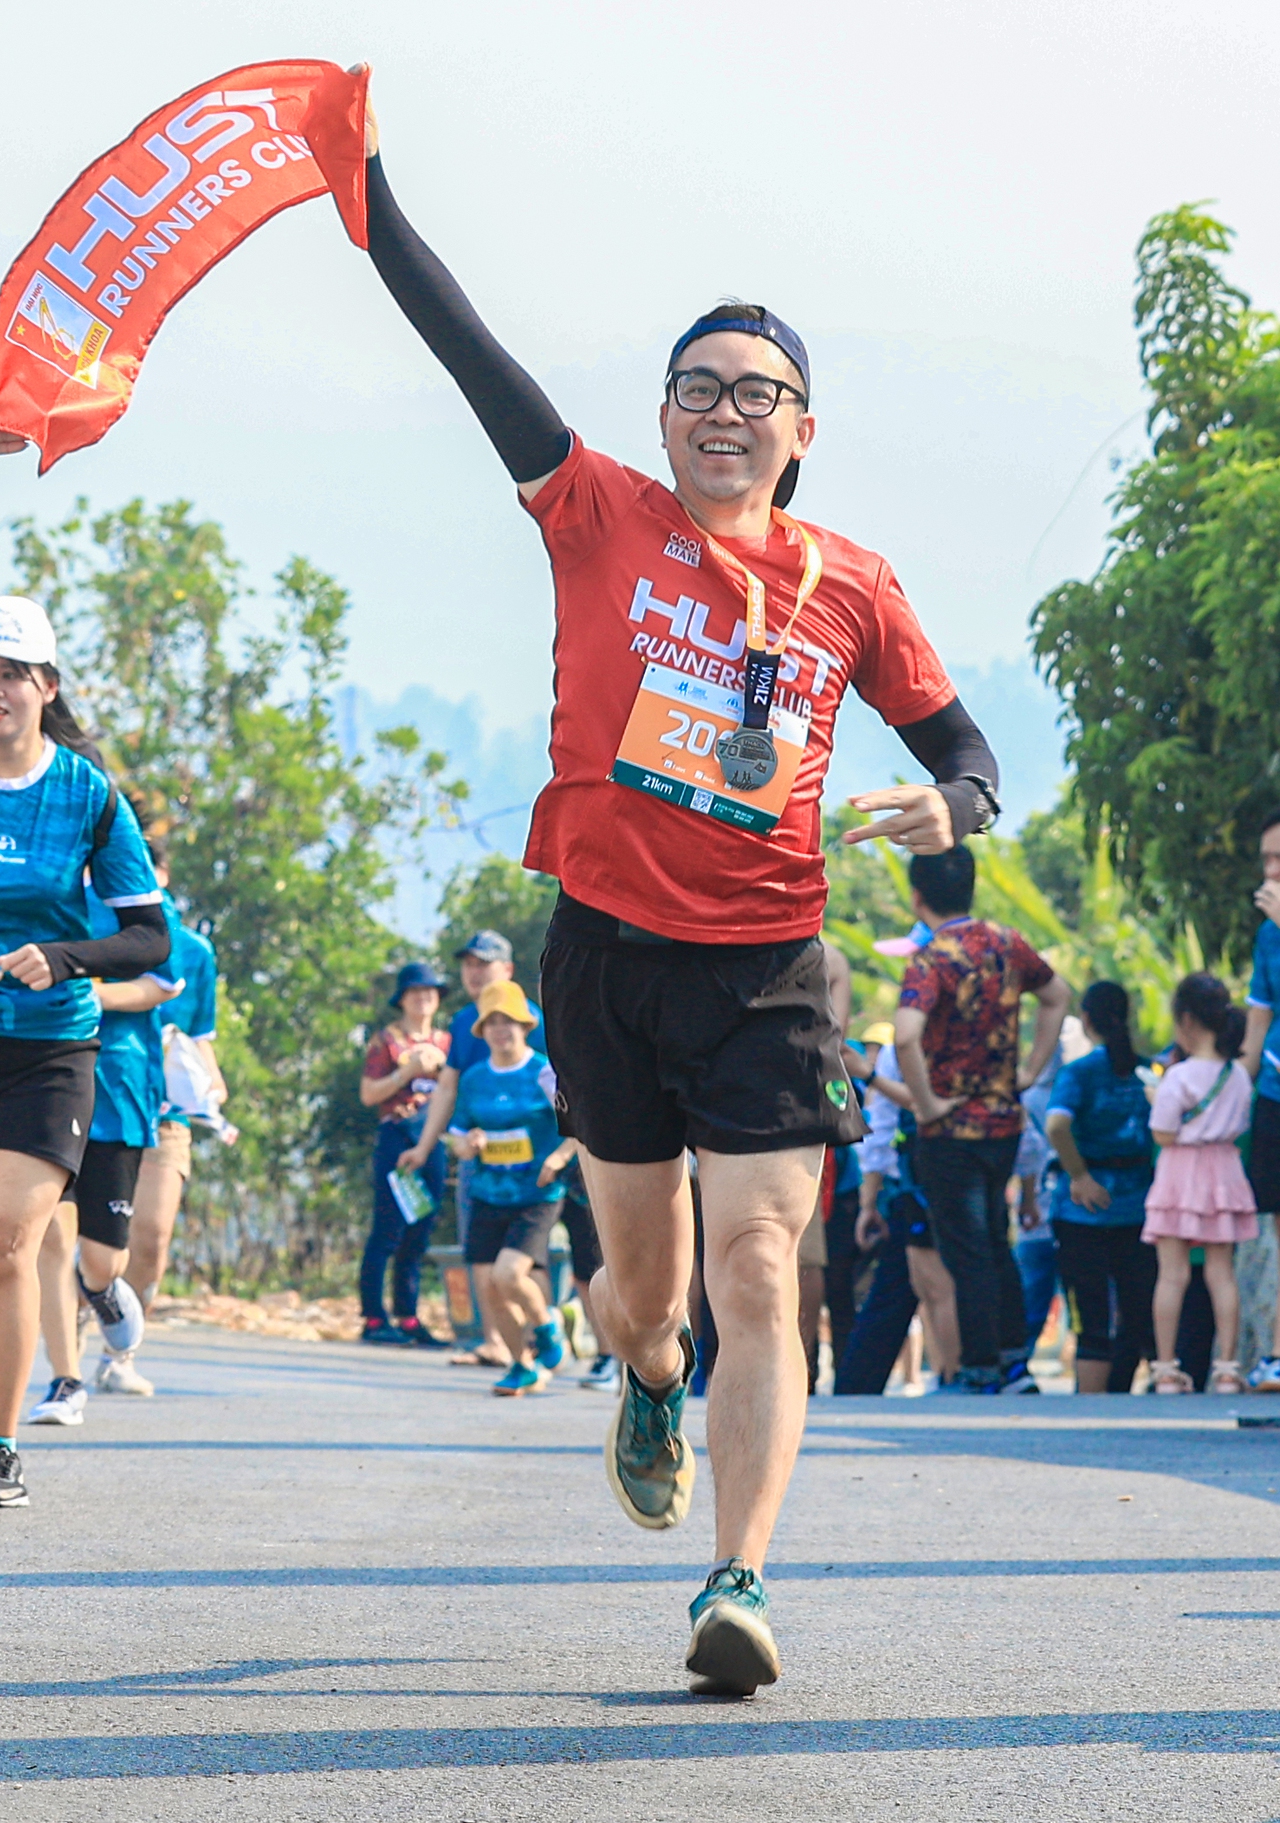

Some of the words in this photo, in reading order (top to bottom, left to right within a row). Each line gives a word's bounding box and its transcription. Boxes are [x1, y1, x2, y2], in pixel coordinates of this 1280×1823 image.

[45, 88, 282, 293] HUST
[97, 159, 252, 318] RUNNERS
[251, 134, 313, 169] CLU
[84, 327, 104, 358] KHOA
[666, 544, 699, 566] MATE
[669, 531, 702, 555] COOL
[751, 582, 762, 639] THACO
[753, 665, 774, 706] 21KM
[659, 709, 734, 764] 20
[642, 773, 673, 796] 21km
